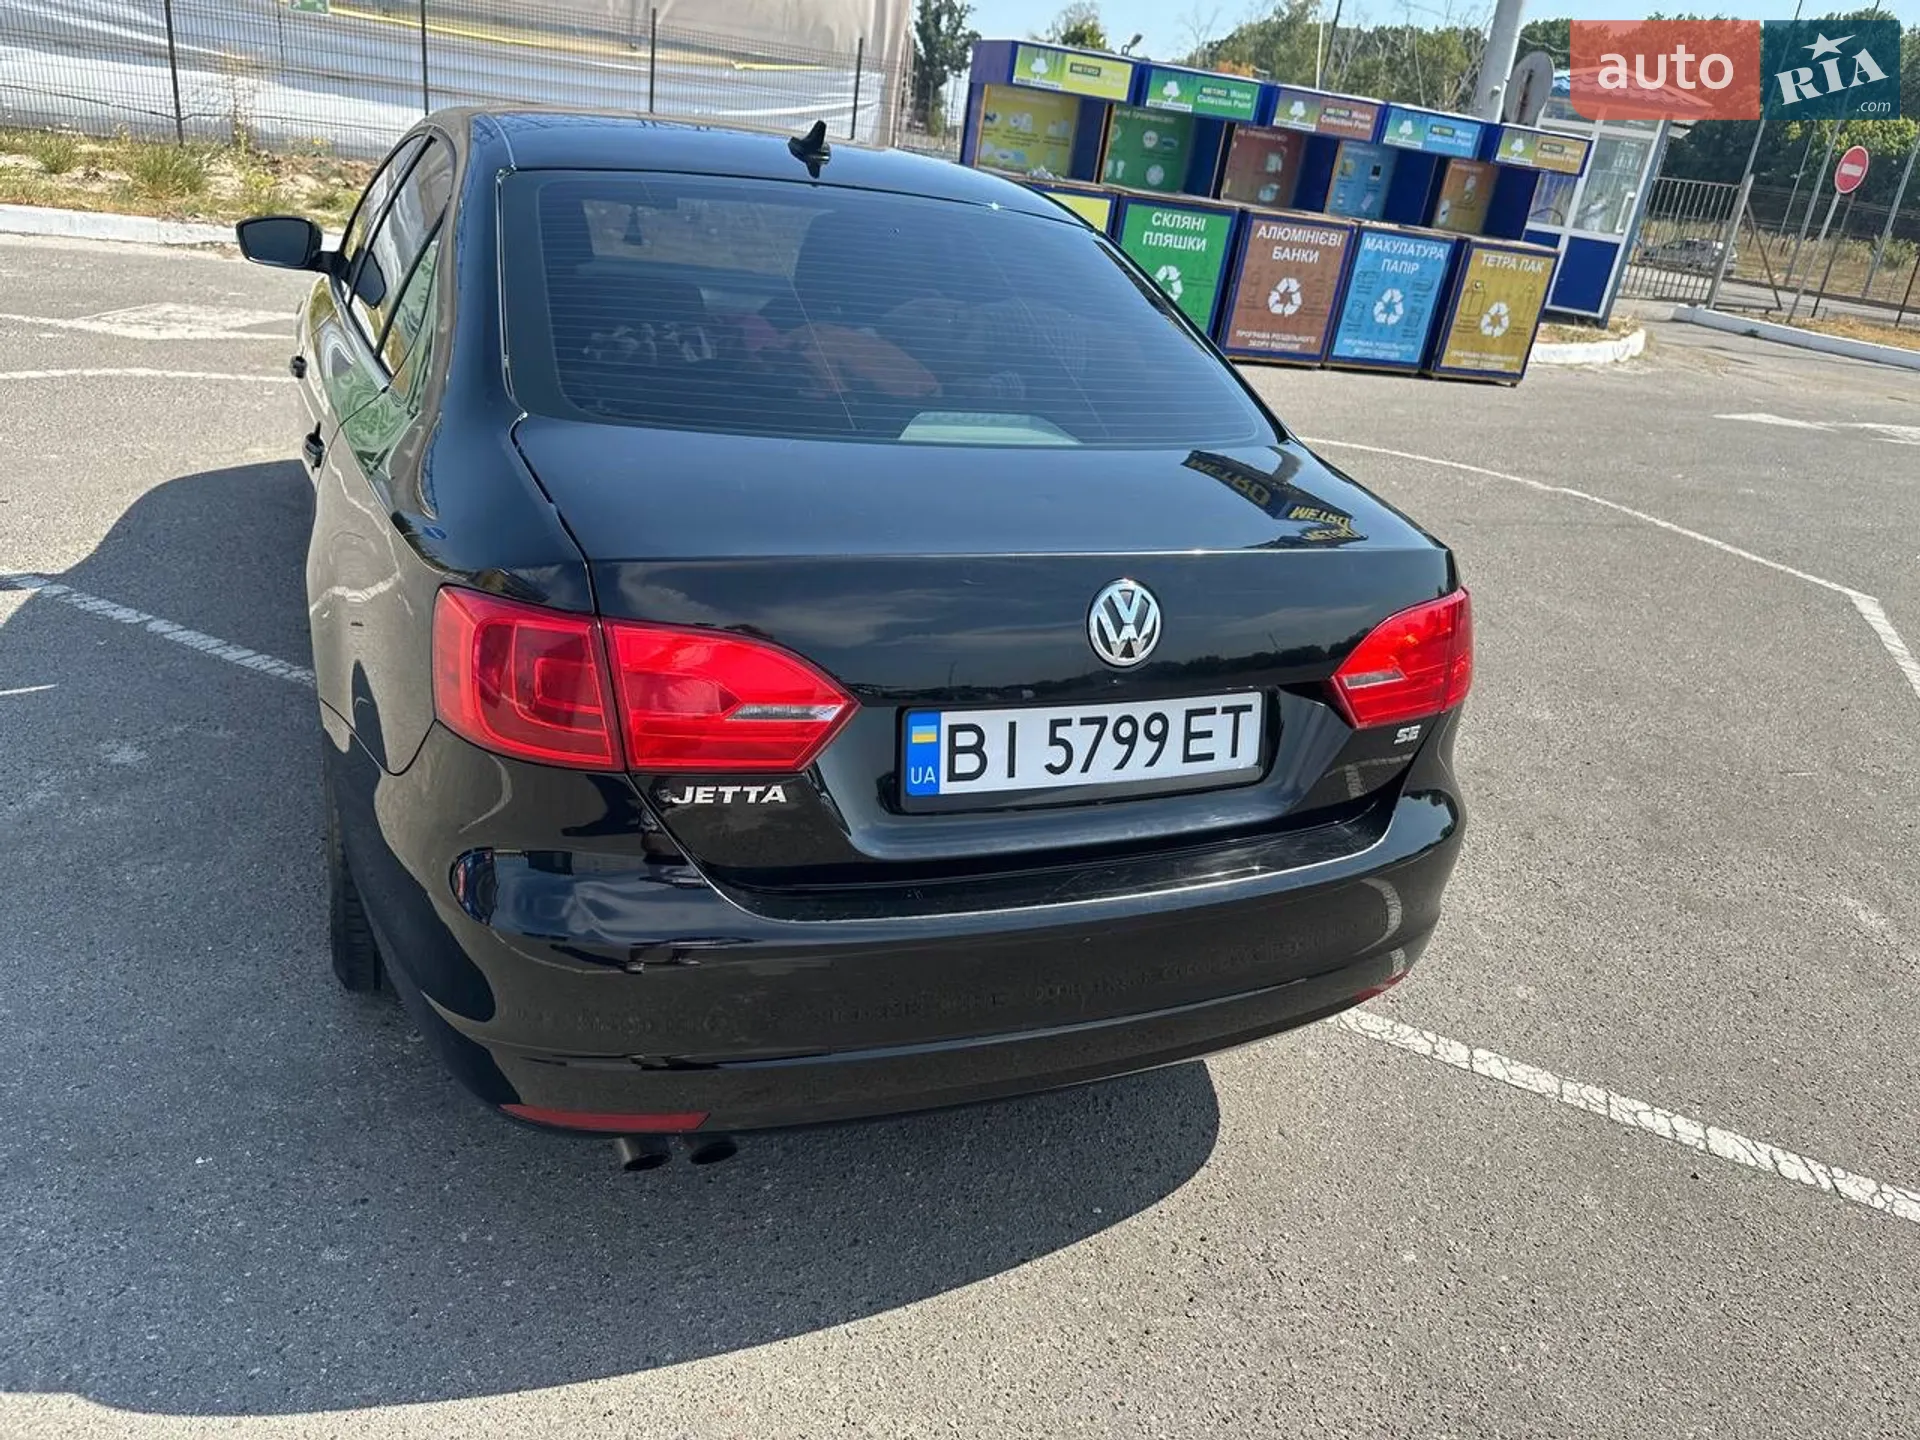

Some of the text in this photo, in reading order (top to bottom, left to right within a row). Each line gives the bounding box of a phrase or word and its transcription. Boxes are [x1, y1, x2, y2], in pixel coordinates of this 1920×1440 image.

[1152, 211, 1207, 232] СКЛЯНІ
[1143, 230, 1208, 252] ПЛЯШКИ
[1256, 225, 1343, 247] АЛЮМІНІЄВІ
[1272, 246, 1320, 264] БАНКИ
[1364, 237, 1446, 260] МАКУЛАТУРА
[1381, 258, 1420, 275] ПАПІР
[1481, 253, 1546, 273] ТЕТРА ПАК
[946, 704, 1253, 783] BI 5799 ET
[910, 765, 936, 785] UA
[671, 785, 788, 804] JETTA
